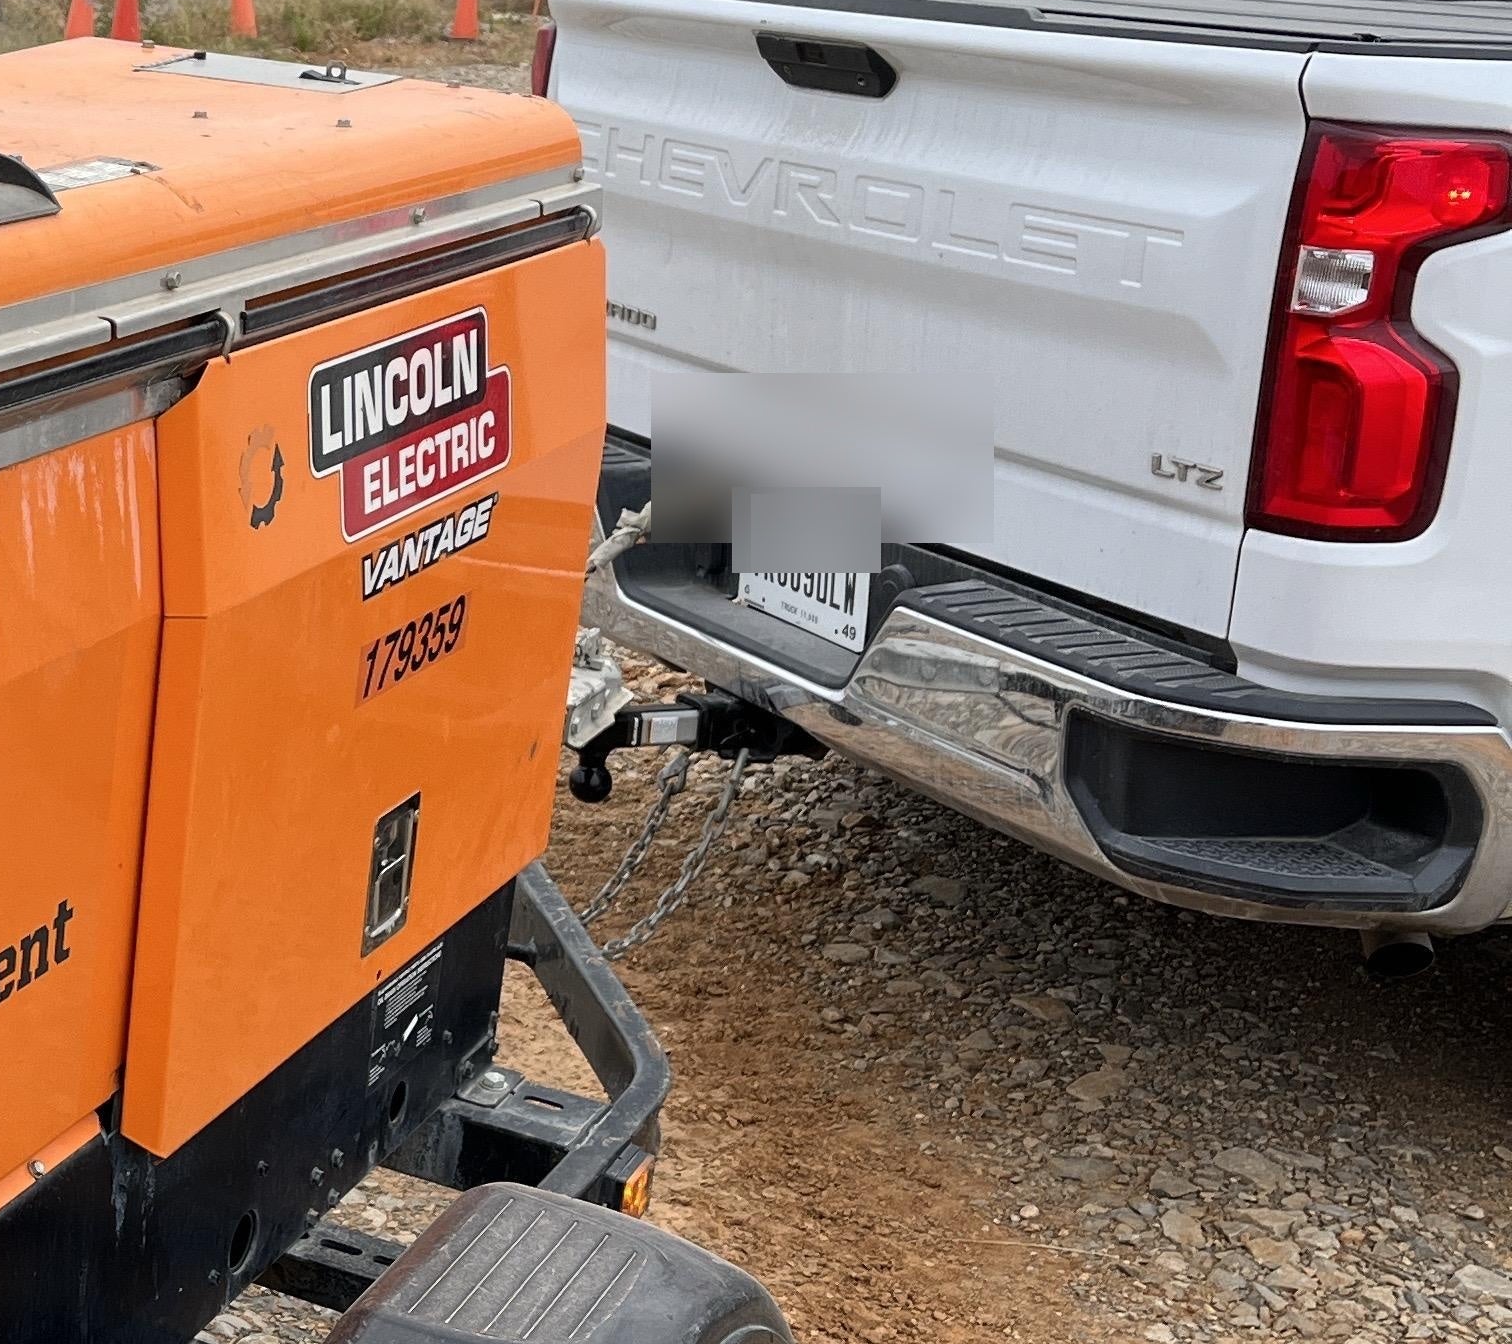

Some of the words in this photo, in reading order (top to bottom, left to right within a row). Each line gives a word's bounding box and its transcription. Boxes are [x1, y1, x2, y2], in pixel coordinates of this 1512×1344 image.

[321, 328, 479, 455] LINCOLN
[363, 410, 496, 515] ELECTRIC
[1151, 452, 1224, 491] LTZ
[363, 495, 494, 600] VANTAGE
[363, 594, 469, 700] 179359
[841, 624, 857, 641] 49
